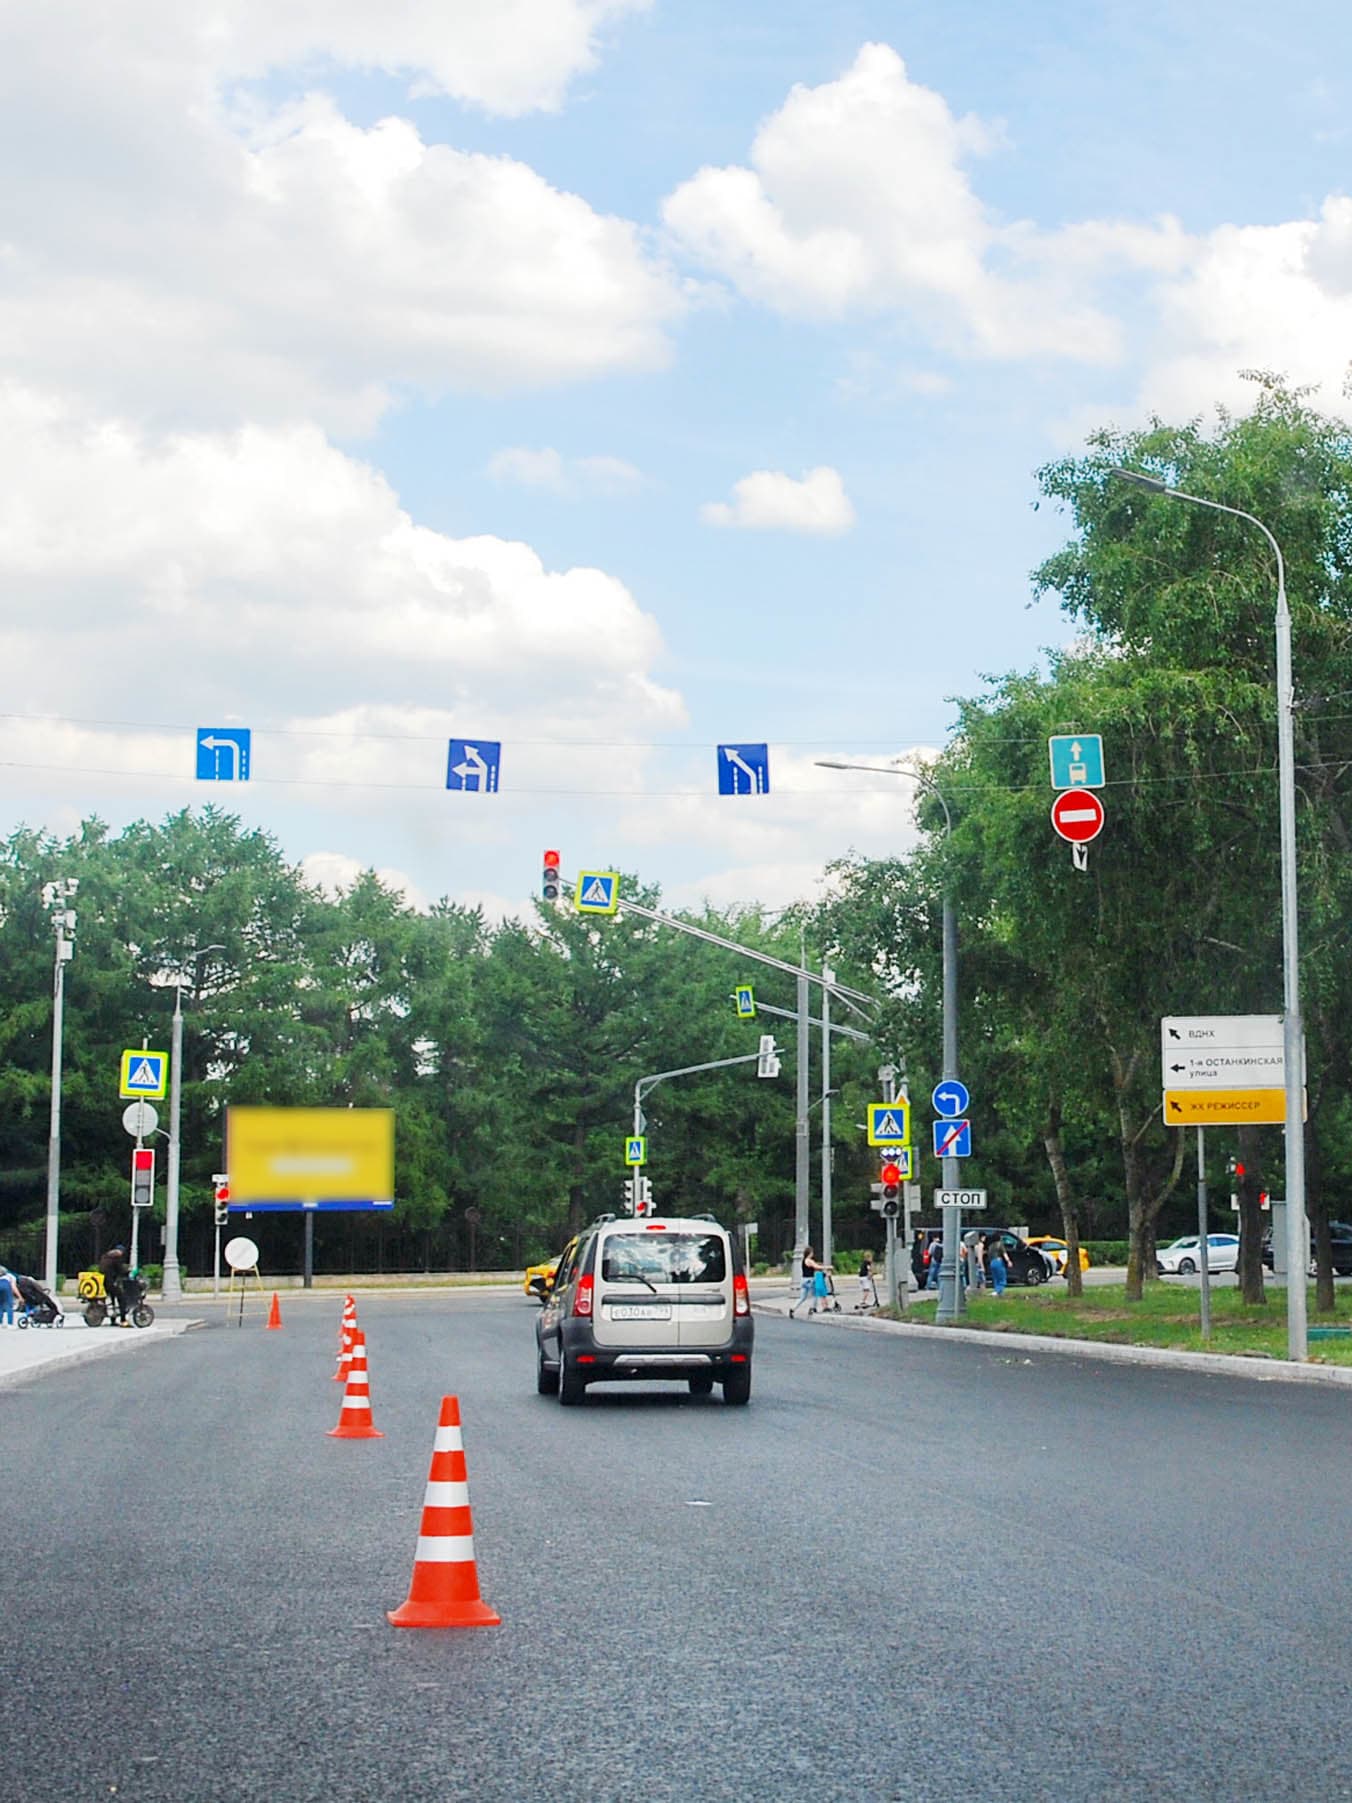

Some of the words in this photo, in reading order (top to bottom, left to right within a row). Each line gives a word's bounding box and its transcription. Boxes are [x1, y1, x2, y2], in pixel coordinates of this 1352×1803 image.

[1188, 1029, 1216, 1038] ВДНХ
[1205, 1056, 1283, 1067] ОСТАНКИНСКАЯ
[1189, 1069, 1218, 1079] улица
[1207, 1101, 1261, 1110] РЕЖИССЕР
[941, 1192, 981, 1205] СТОП
